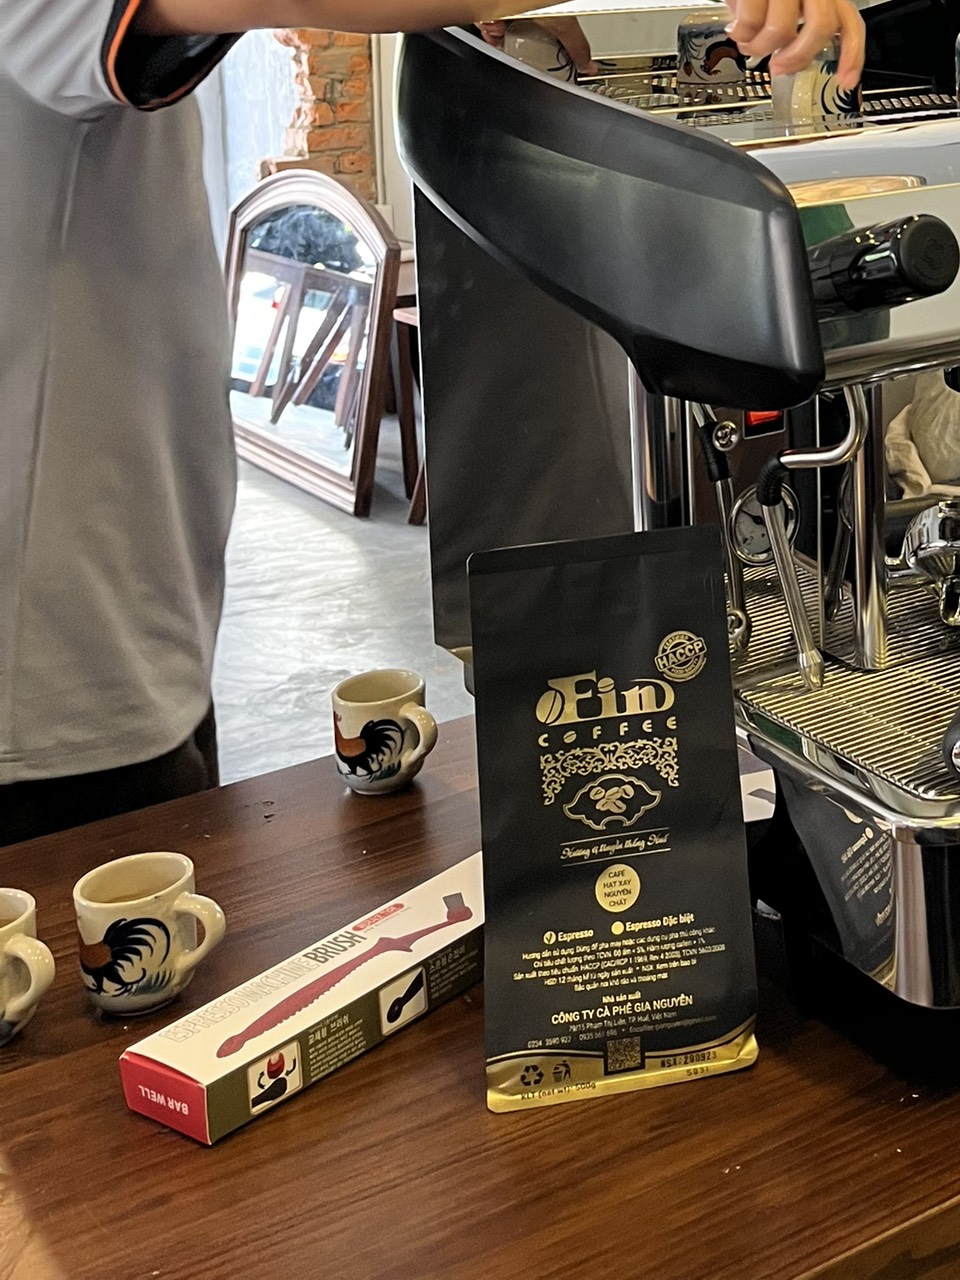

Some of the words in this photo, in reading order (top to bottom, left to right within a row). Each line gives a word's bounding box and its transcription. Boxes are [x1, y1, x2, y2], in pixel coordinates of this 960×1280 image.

[657, 640, 703, 669] HACCP
[557, 928, 594, 942] Espresso
[625, 918, 662, 932] Espresso
[160, 991, 249, 1043] ESPRESSO
[303, 930, 368, 965] BRUSH
[552, 1010, 580, 1024] CÔNG
[581, 1009, 595, 1020] TY
[596, 1004, 611, 1019] CÀ
[612, 1001, 632, 1016] PHÊ
[634, 1000, 651, 1013] GIA
[652, 993, 693, 1010] NGUYÊN
[138, 1085, 167, 1108] WELL
[167, 1097, 189, 1115] BAR
